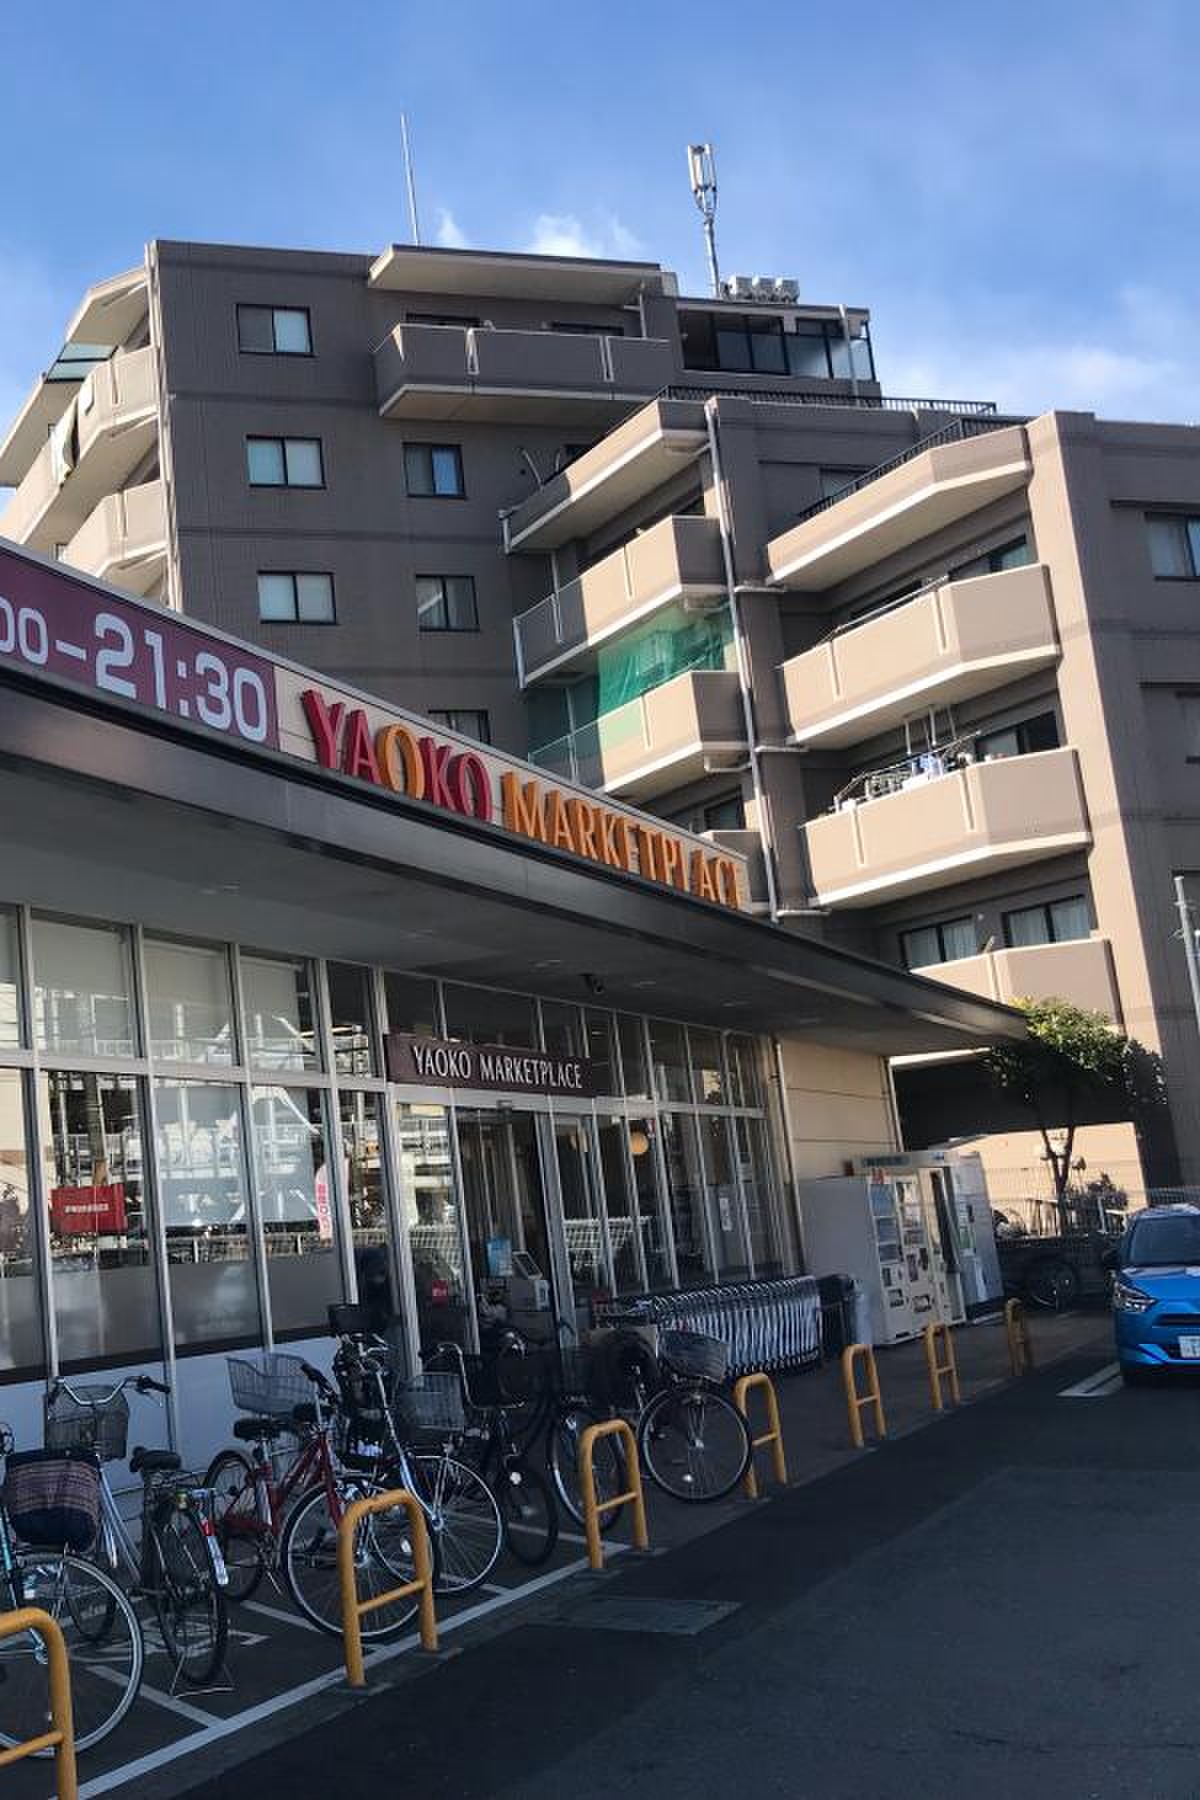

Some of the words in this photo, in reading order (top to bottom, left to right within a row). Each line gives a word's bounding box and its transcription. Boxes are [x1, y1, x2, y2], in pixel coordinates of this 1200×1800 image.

[302, 689, 494, 823] YAOKO
[413, 1045, 472, 1080] YAOKO
[479, 1054, 584, 1089] MARKETPLACE
